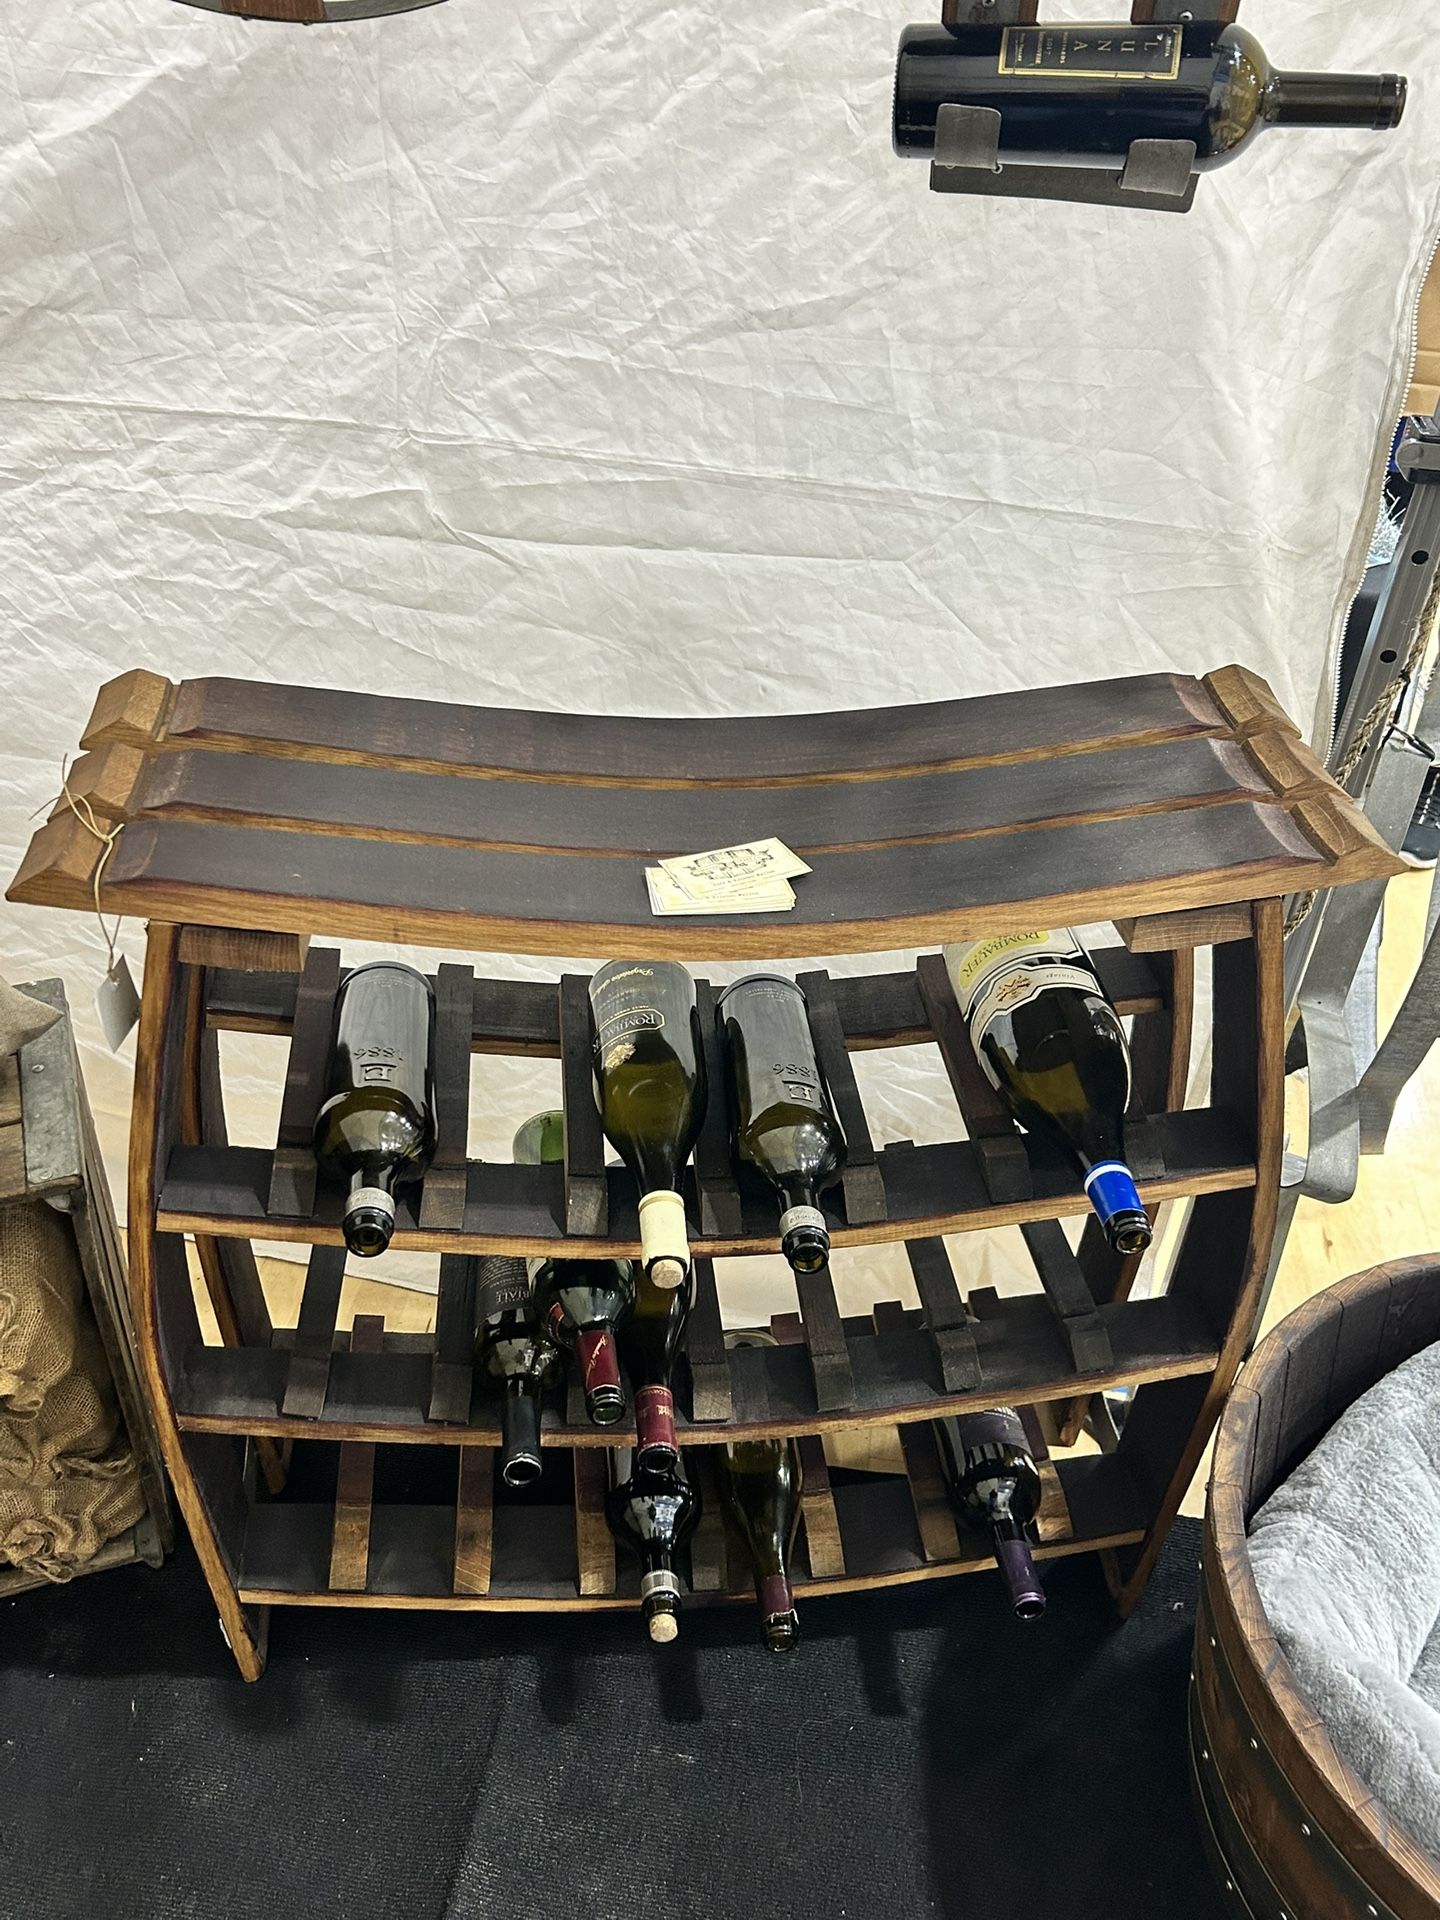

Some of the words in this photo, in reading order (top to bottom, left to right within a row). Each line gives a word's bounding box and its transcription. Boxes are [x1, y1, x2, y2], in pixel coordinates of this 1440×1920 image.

[1072, 39, 1160, 54] LUNA
[1045, 971, 1077, 981] Vintage
[352, 1046, 406, 1061] 1886
[770, 1063, 819, 1082] 1886
[495, 1289, 530, 1304] BIALE
